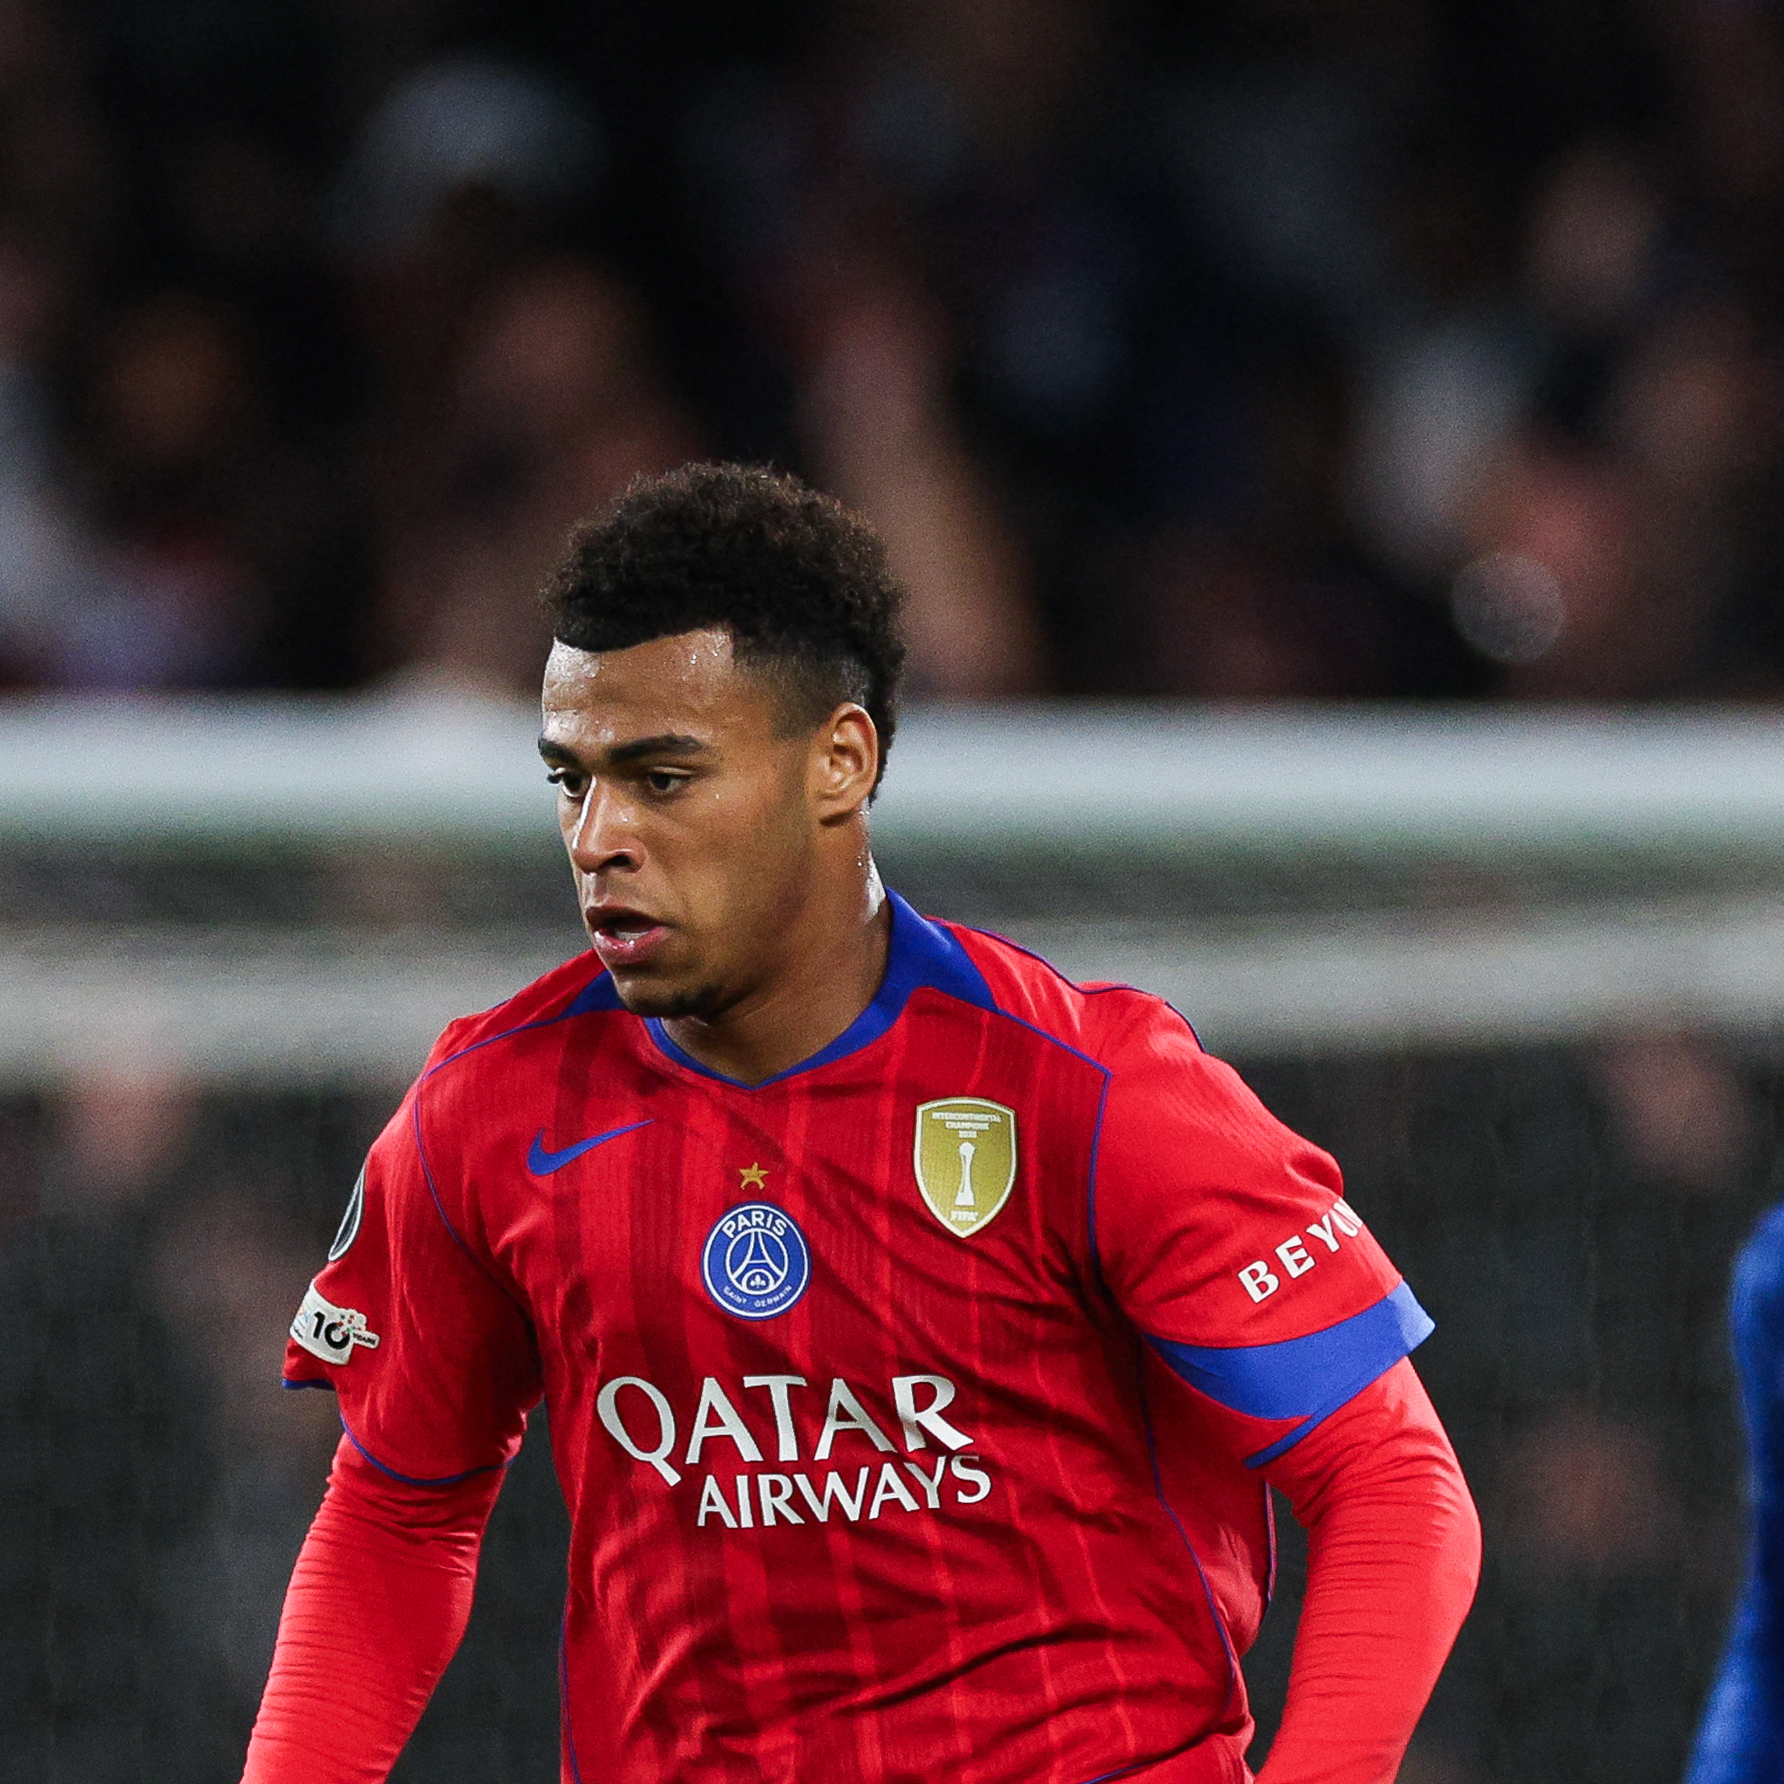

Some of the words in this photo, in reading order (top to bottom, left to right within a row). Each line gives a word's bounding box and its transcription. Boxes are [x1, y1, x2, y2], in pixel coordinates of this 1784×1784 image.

[722, 1210, 787, 1239] PARIS
[313, 1311, 350, 1350] 10
[597, 1375, 974, 1487] QATAR
[697, 1455, 992, 1529] AIRWAYS
